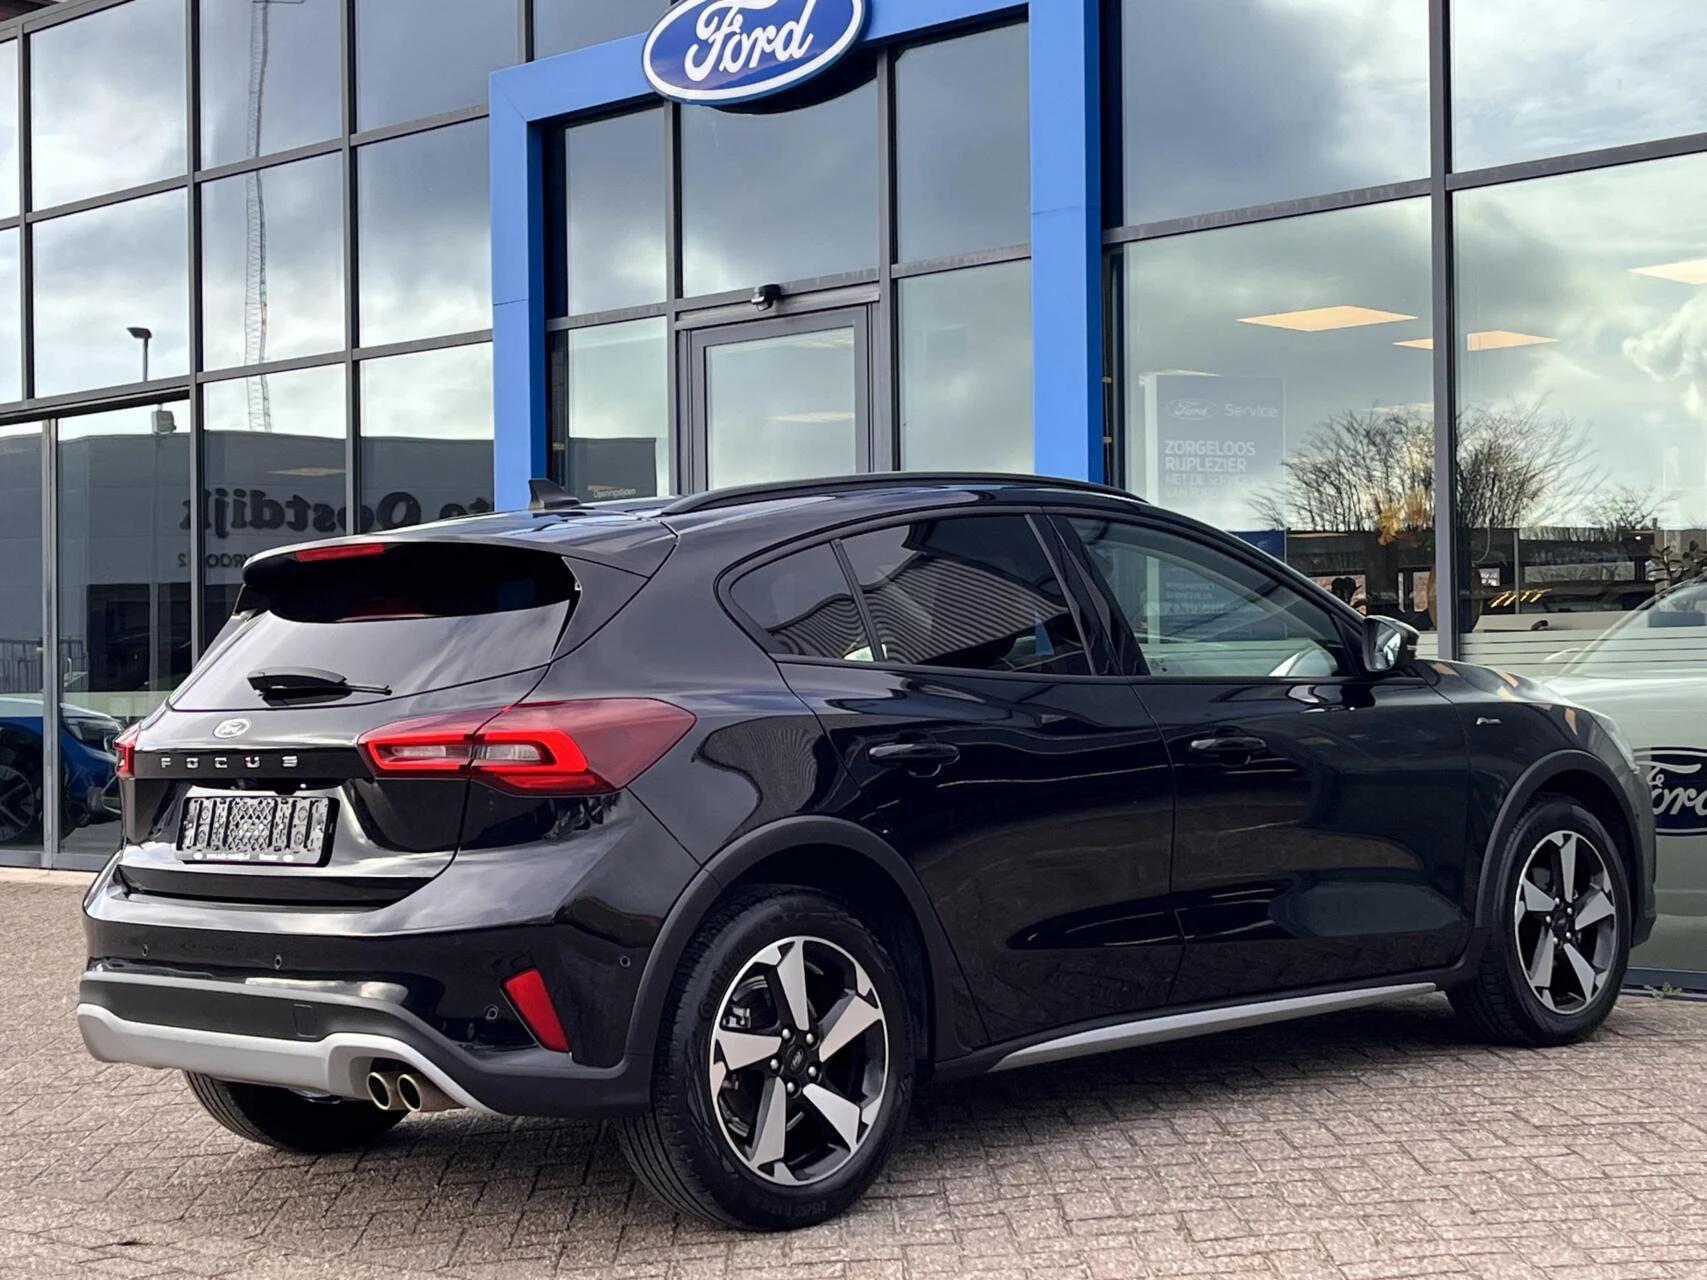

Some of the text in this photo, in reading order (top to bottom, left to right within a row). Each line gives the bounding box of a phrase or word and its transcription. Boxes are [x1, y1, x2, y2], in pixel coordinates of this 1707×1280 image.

[684, 0, 815, 82] Ford
[1174, 401, 1278, 418] Ford Service
[1164, 440, 1256, 456] ZORGELOOS
[1165, 456, 1247, 472] RIJPLEZIER
[161, 756, 298, 768] FOCUS
